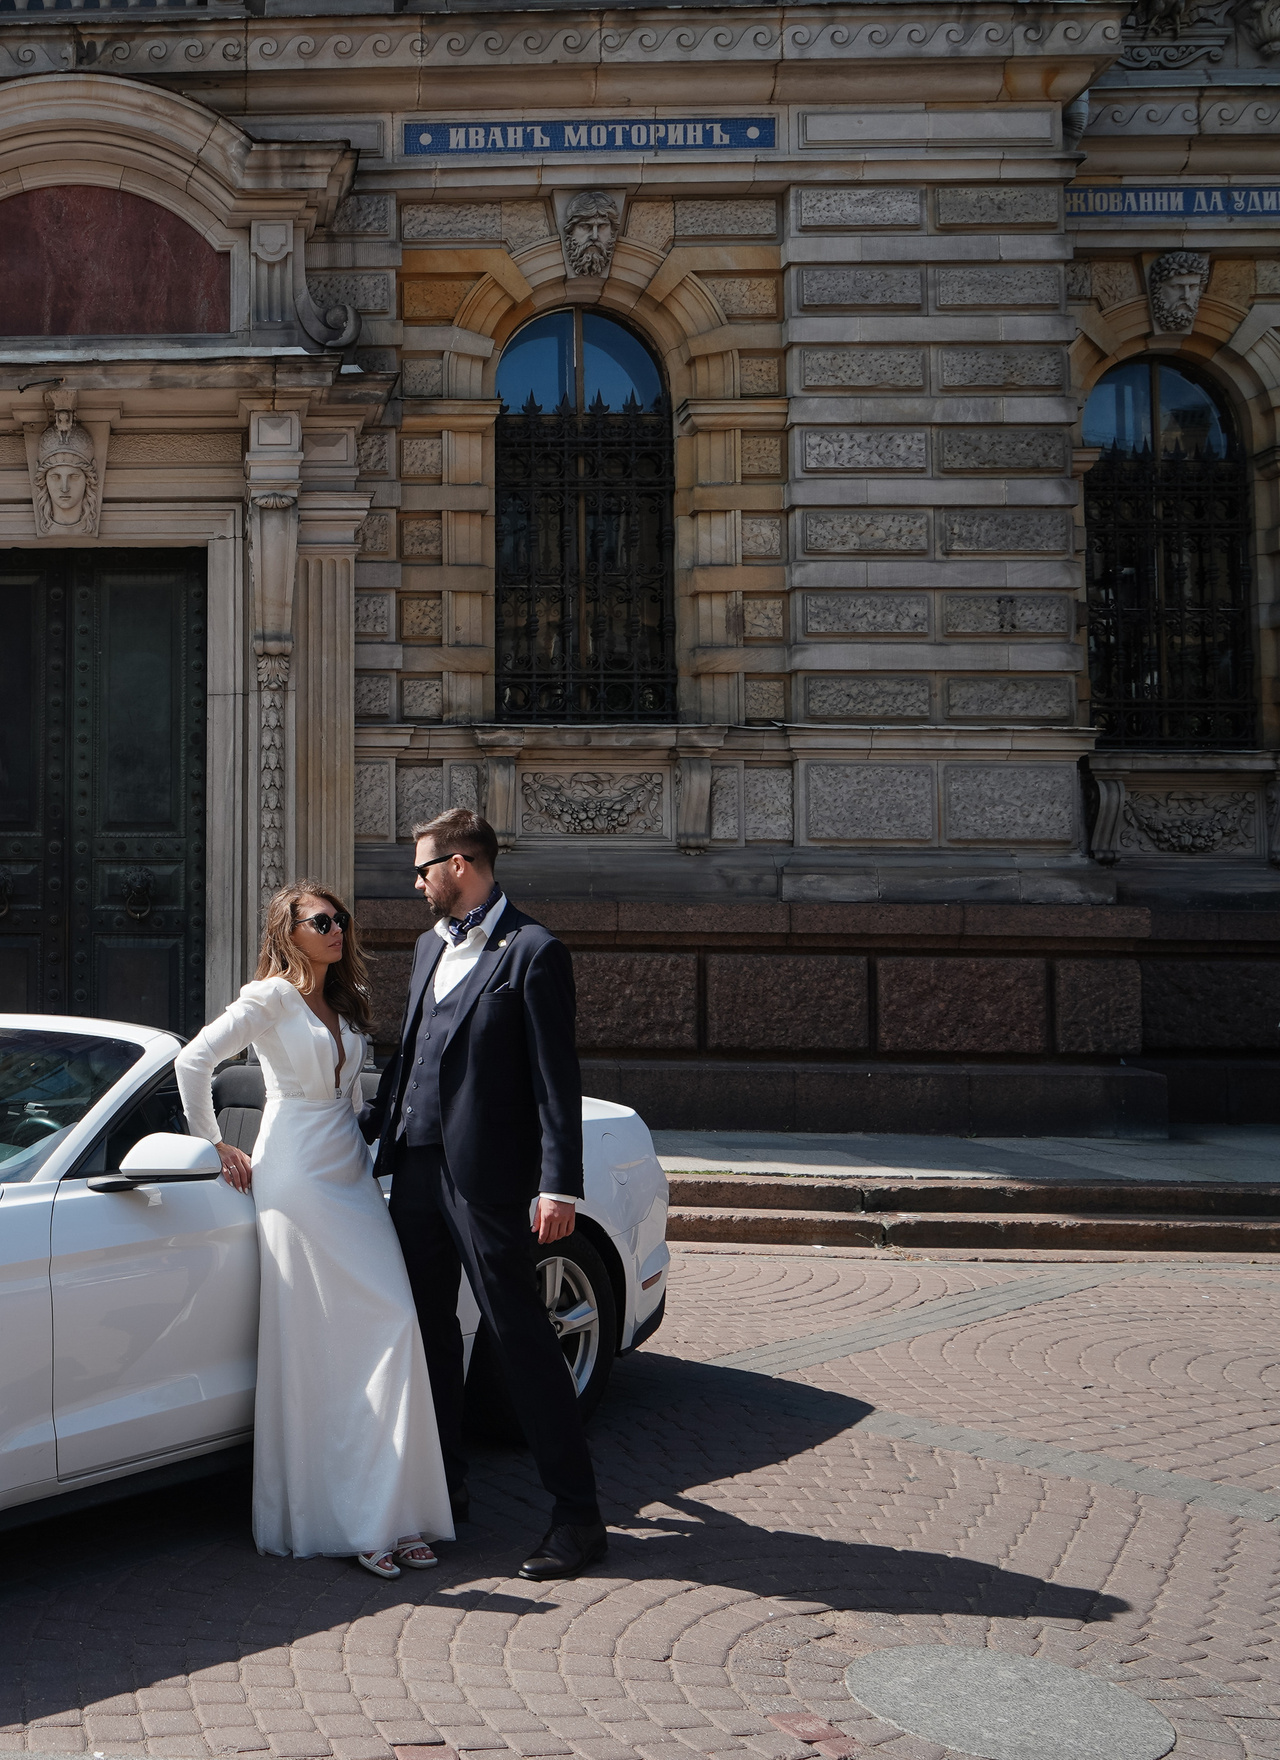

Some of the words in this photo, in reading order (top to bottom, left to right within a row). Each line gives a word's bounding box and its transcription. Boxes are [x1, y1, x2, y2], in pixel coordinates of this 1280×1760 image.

[448, 125, 551, 150] ИВАНЪ
[563, 122, 731, 147] МОТОРИНЪ
[1193, 190, 1224, 213] ДА
[1231, 190, 1280, 213] УДИ
